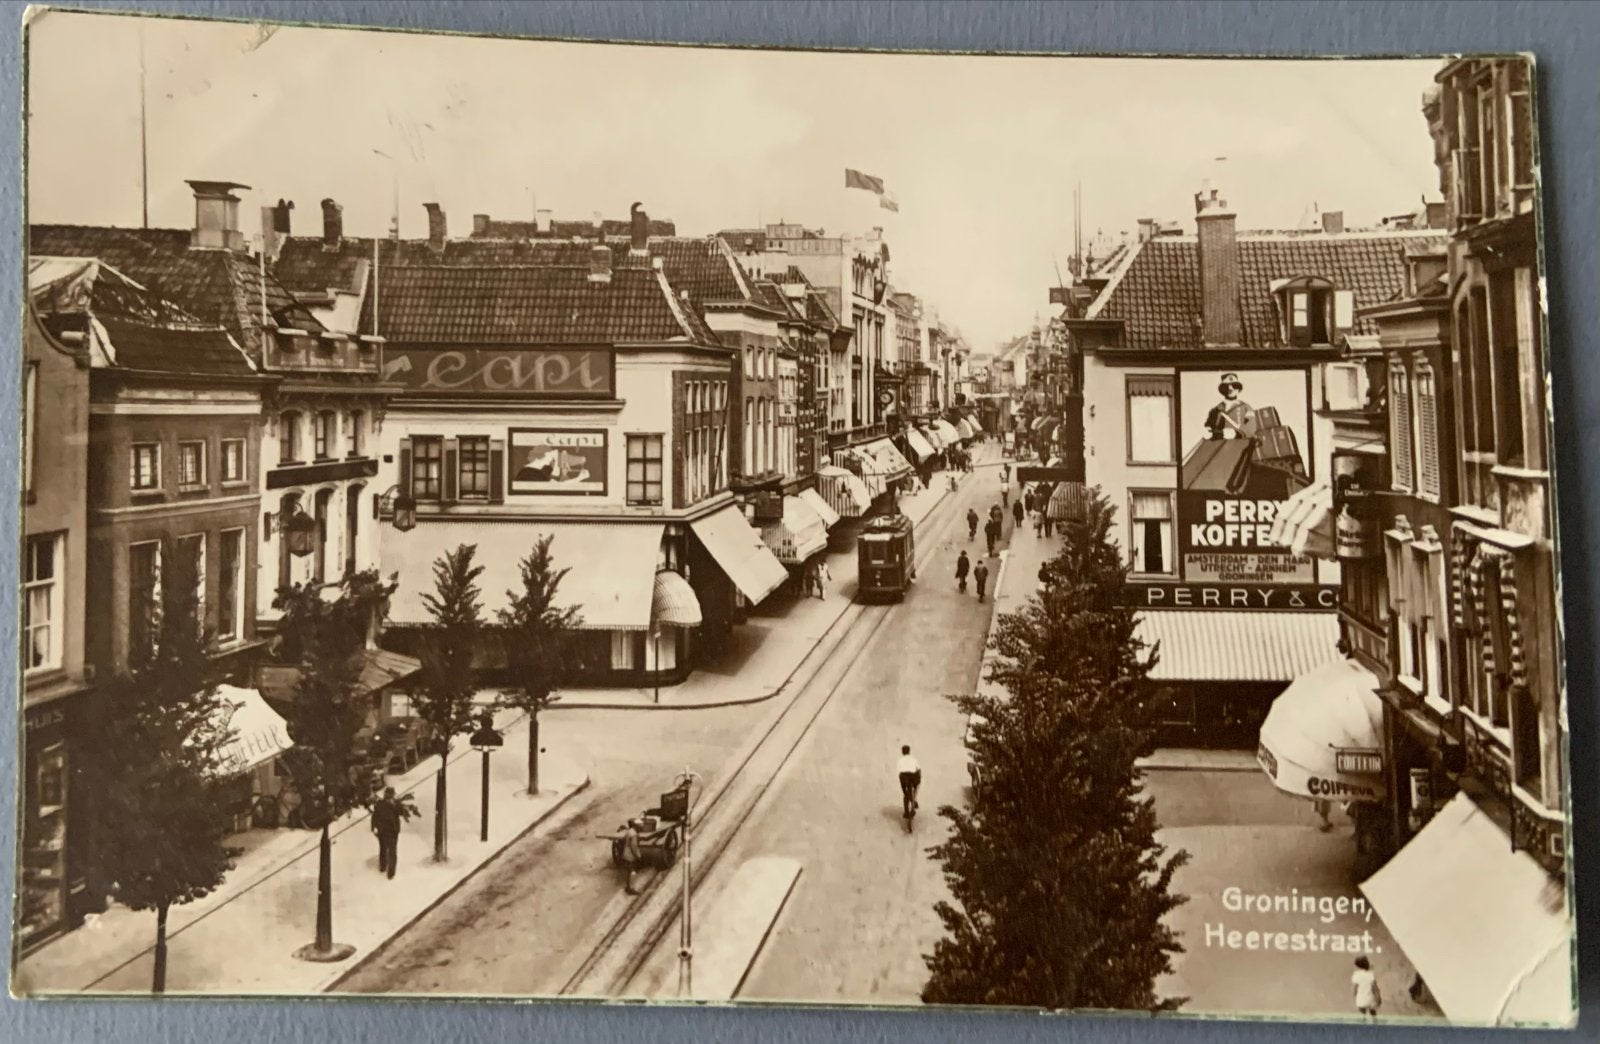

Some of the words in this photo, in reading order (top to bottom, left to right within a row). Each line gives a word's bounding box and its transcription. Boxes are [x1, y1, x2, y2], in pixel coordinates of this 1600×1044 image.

[1191, 524, 1273, 546] KOFFE
[1187, 555, 1248, 564] AMSTERDAM
[1258, 555, 1278, 563] DEN
[1200, 564, 1245, 572] UTRECHT
[1255, 564, 1297, 572] ARNHEM
[1148, 587, 1273, 606] PERRY
[1289, 591, 1305, 606] &
[1317, 590, 1339, 607] C
